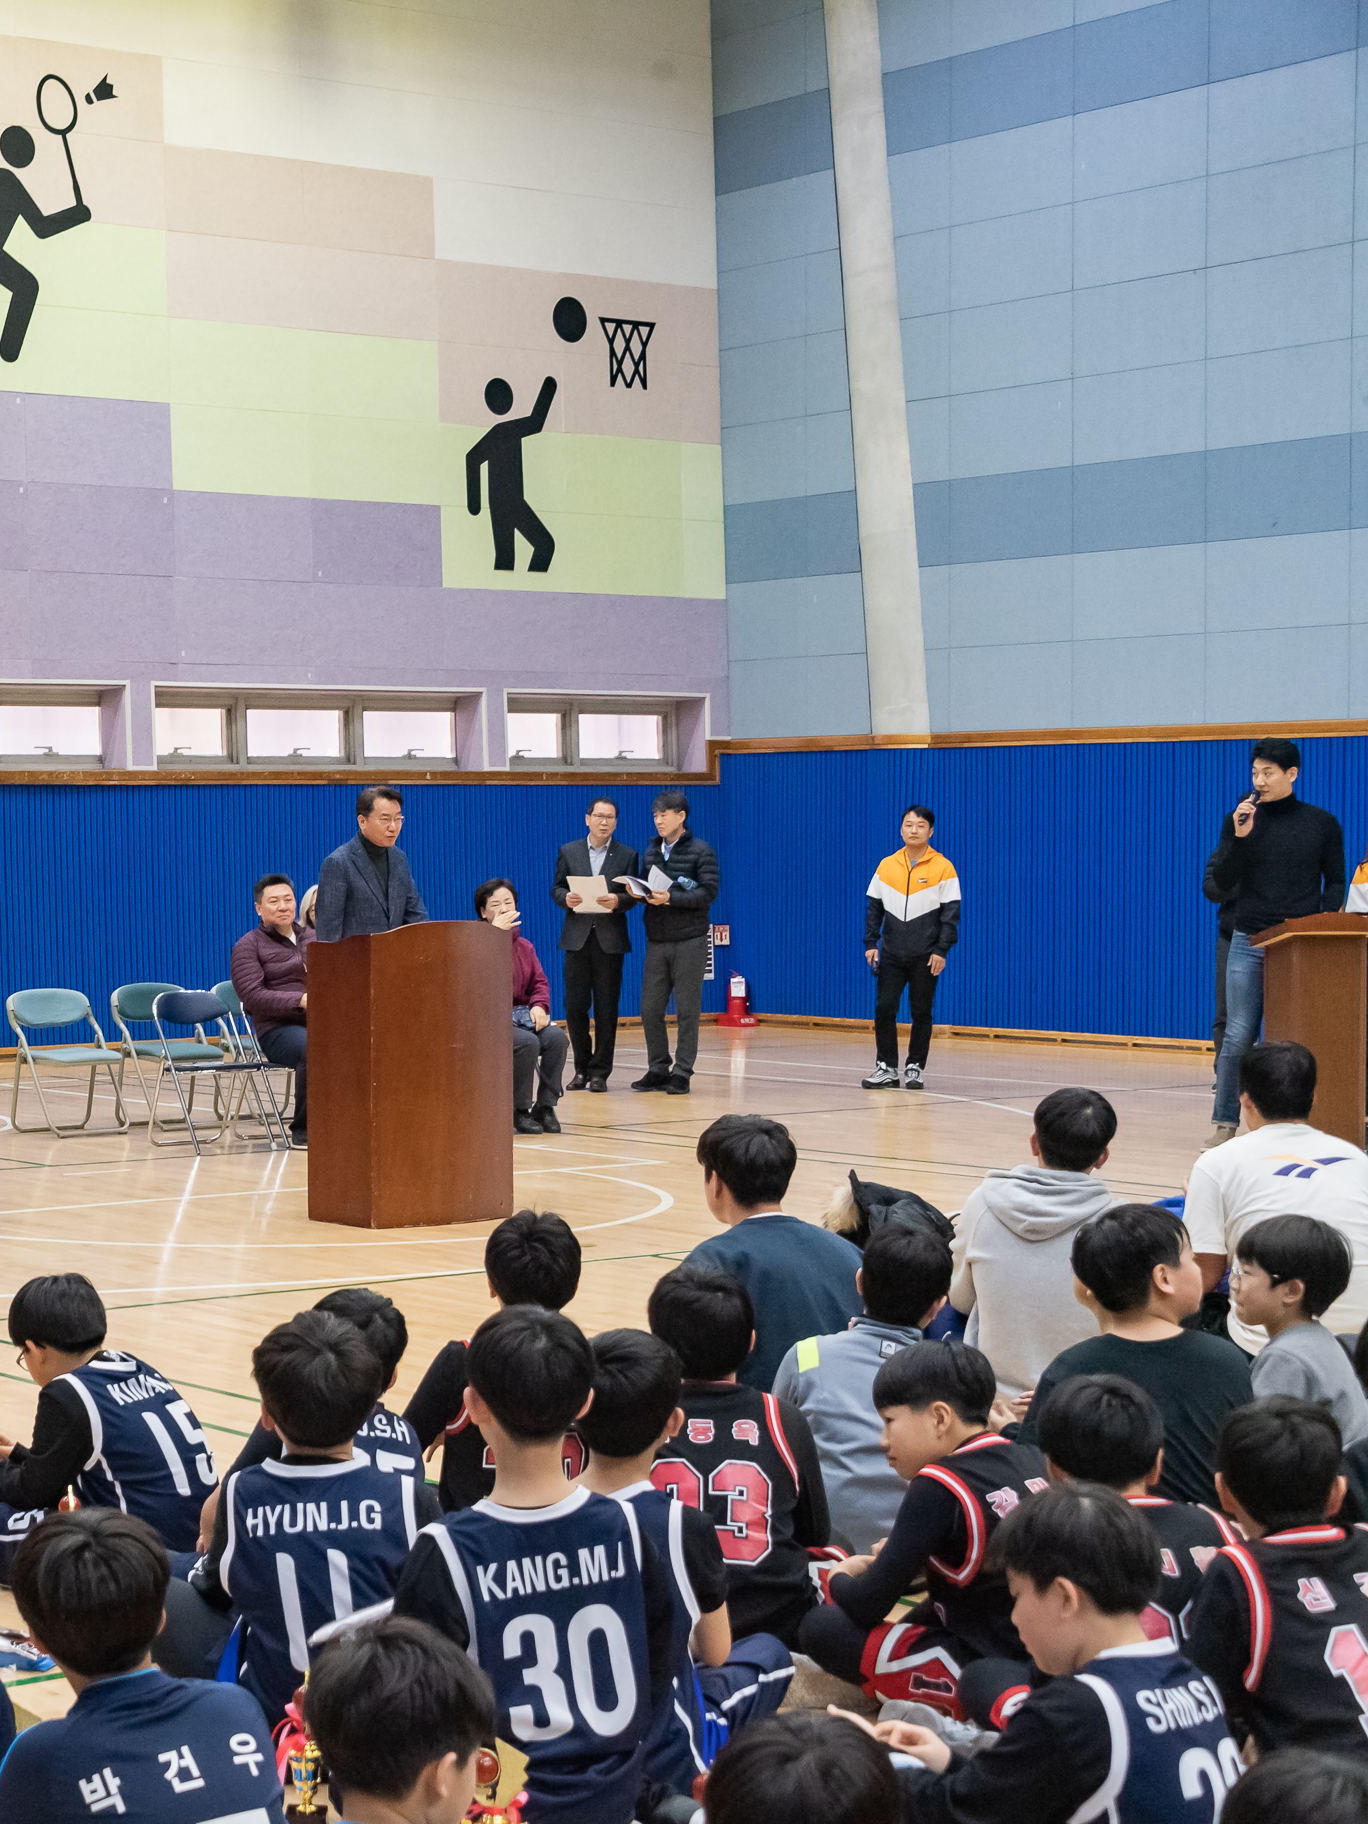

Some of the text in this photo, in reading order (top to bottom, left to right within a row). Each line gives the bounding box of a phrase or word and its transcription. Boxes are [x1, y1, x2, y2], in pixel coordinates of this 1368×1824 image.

[141, 1399, 219, 1497] 15
[687, 1418, 759, 1446] 동욱
[246, 1499, 382, 1539] HYUN.J.G
[275, 1548, 354, 1673] 11
[476, 1541, 626, 1602] KANG.M.J
[502, 1603, 638, 1742] 30
